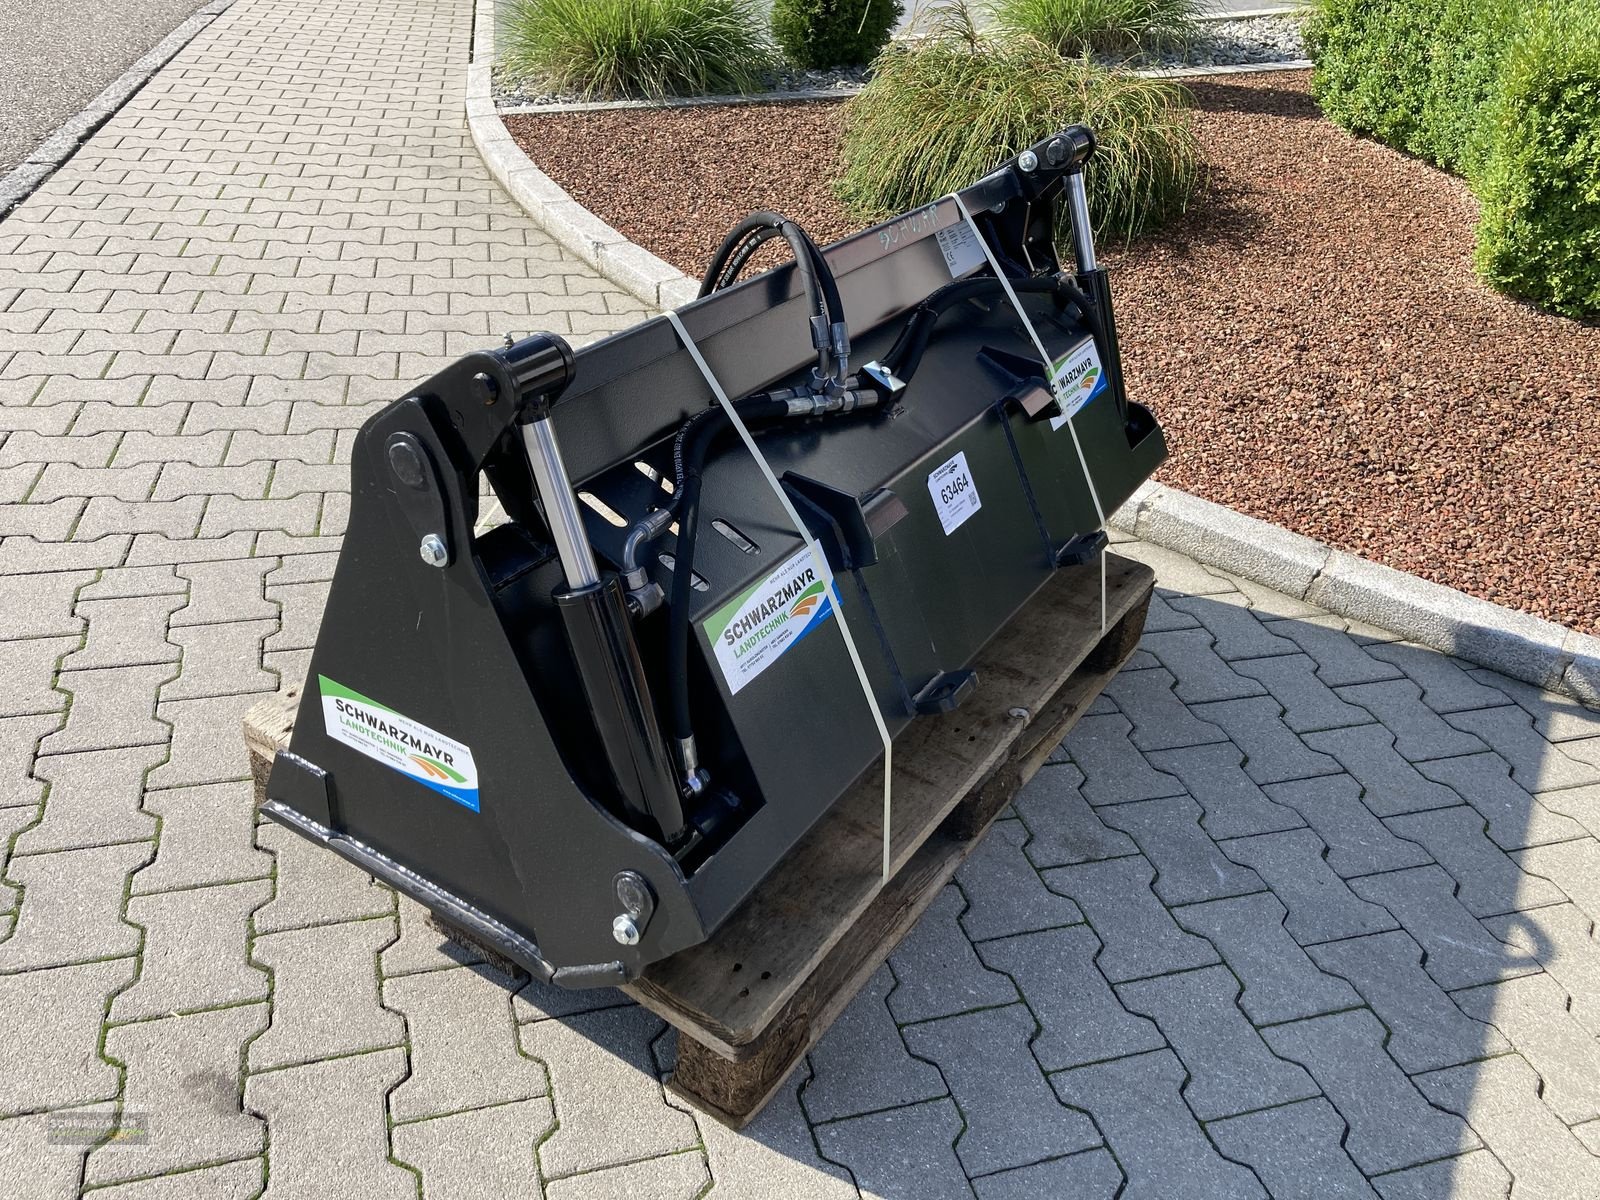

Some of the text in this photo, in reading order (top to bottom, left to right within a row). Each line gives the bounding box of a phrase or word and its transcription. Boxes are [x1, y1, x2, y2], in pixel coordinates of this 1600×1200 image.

[941, 473, 969, 504] 63464
[723, 568, 816, 646] SCHWARZMAYR
[733, 611, 790, 659] LANDTECHNIK
[335, 699, 454, 767] SCHWARZMAYR
[339, 716, 407, 756] LANDTECHNIK
